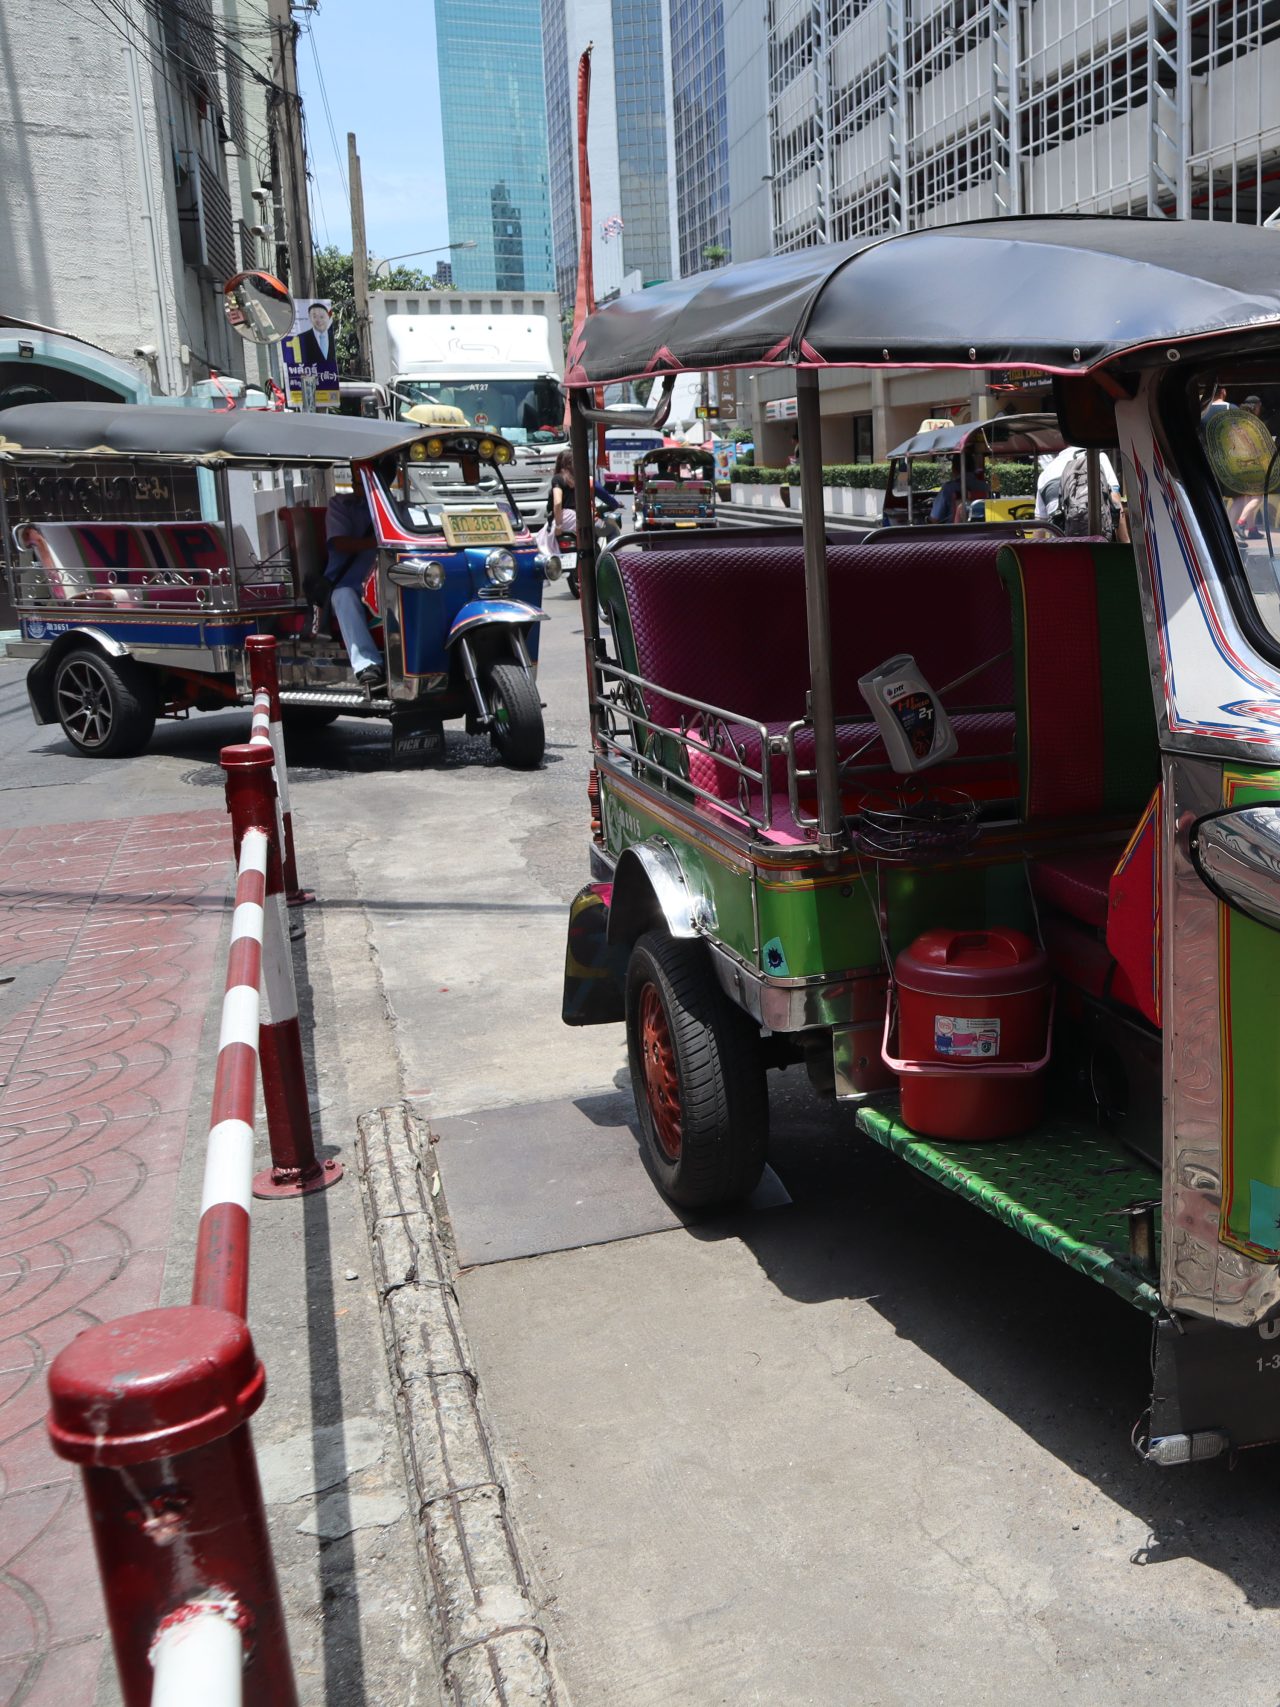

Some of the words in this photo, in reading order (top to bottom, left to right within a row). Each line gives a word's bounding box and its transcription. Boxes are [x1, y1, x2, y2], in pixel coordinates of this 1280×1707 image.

[286, 335, 302, 364] 1
[473, 515, 507, 532] 3651
[918, 707, 934, 720] 2T
[398, 739, 420, 752] PICK
[424, 736, 438, 749] UP
[1256, 1354, 1280, 1372] 1-3
